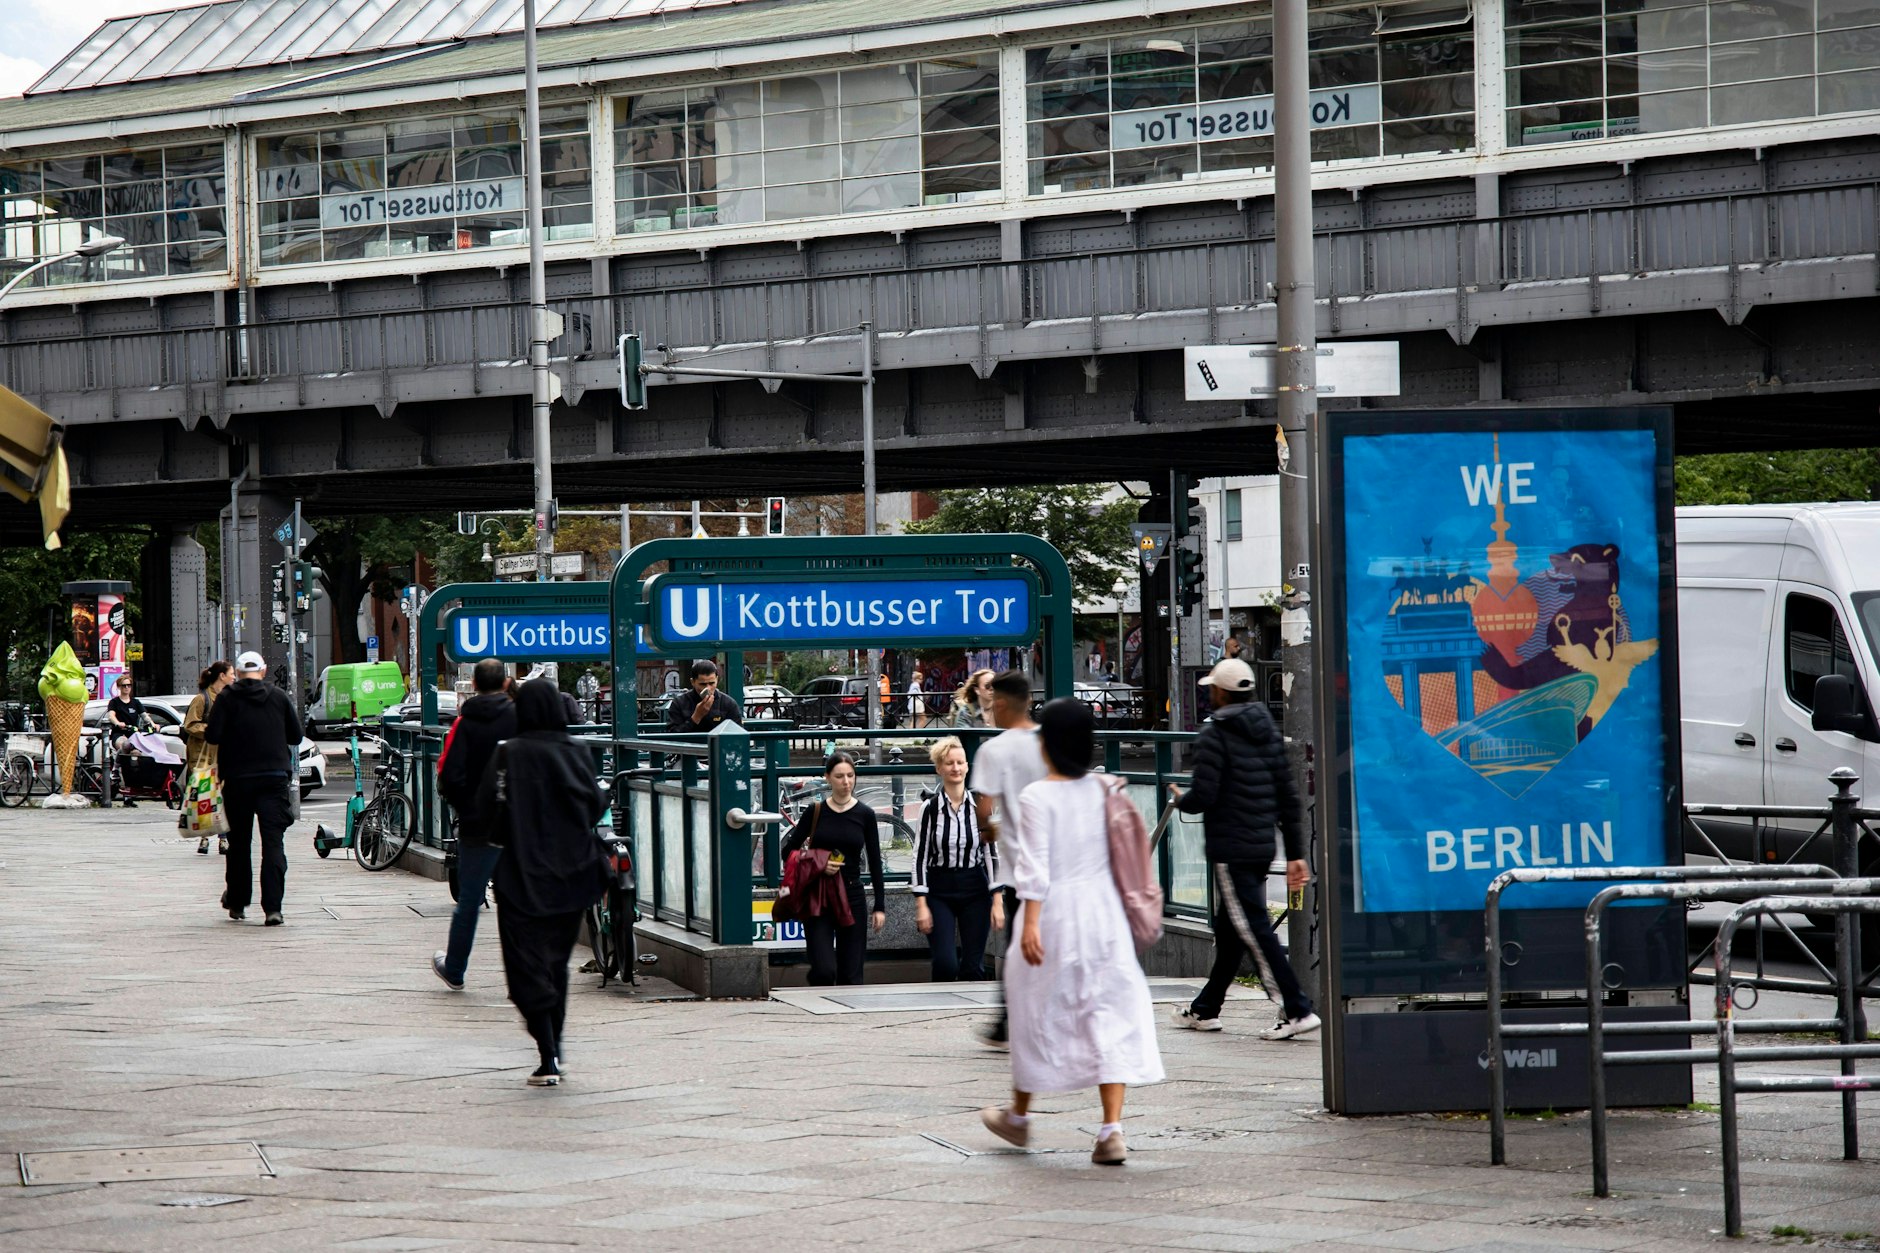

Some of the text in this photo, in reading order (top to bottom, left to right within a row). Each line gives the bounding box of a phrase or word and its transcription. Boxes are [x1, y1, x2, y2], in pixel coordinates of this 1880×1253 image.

[1460, 462, 1538, 507] WE
[670, 588, 1016, 637] U Kottbusser Tor
[369, 638, 376, 648] P
[460, 618, 488, 654] U
[1426, 821, 1614, 873] BERLIN
[1503, 1048, 1557, 1068] Wall
